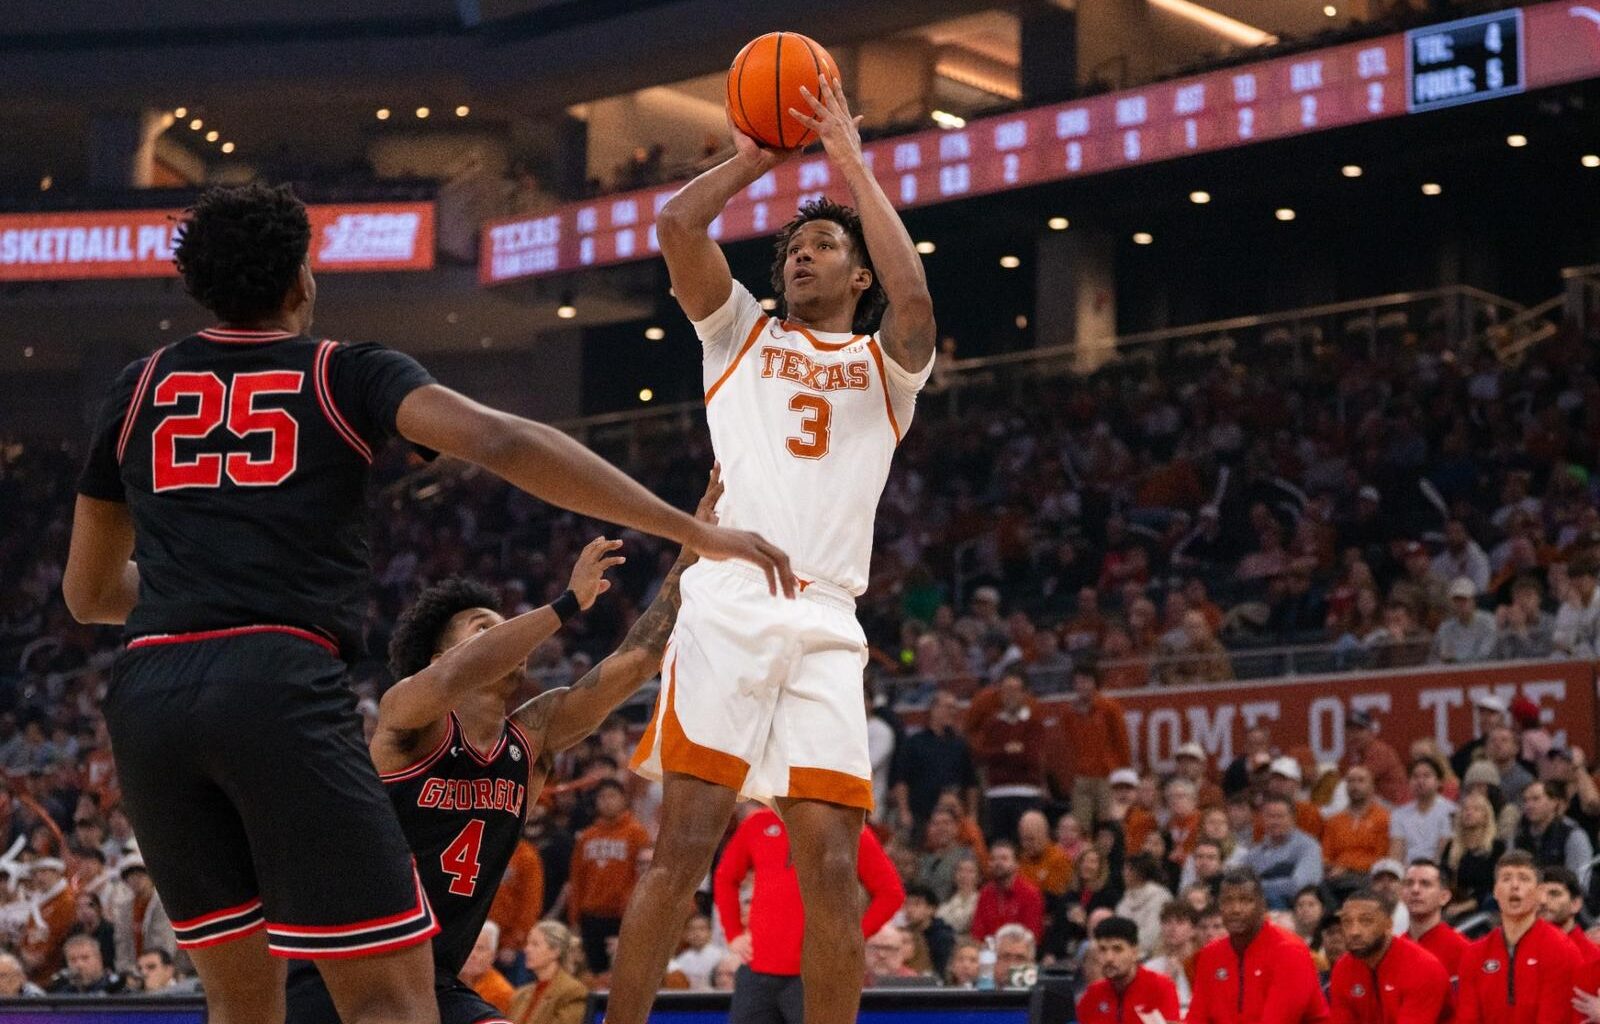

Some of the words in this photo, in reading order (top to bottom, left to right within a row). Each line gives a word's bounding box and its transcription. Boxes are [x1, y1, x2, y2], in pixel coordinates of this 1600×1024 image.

[760, 345, 870, 392] TEXAS
[152, 370, 305, 493] 25
[786, 391, 832, 460] 3
[440, 818, 486, 897] 4
